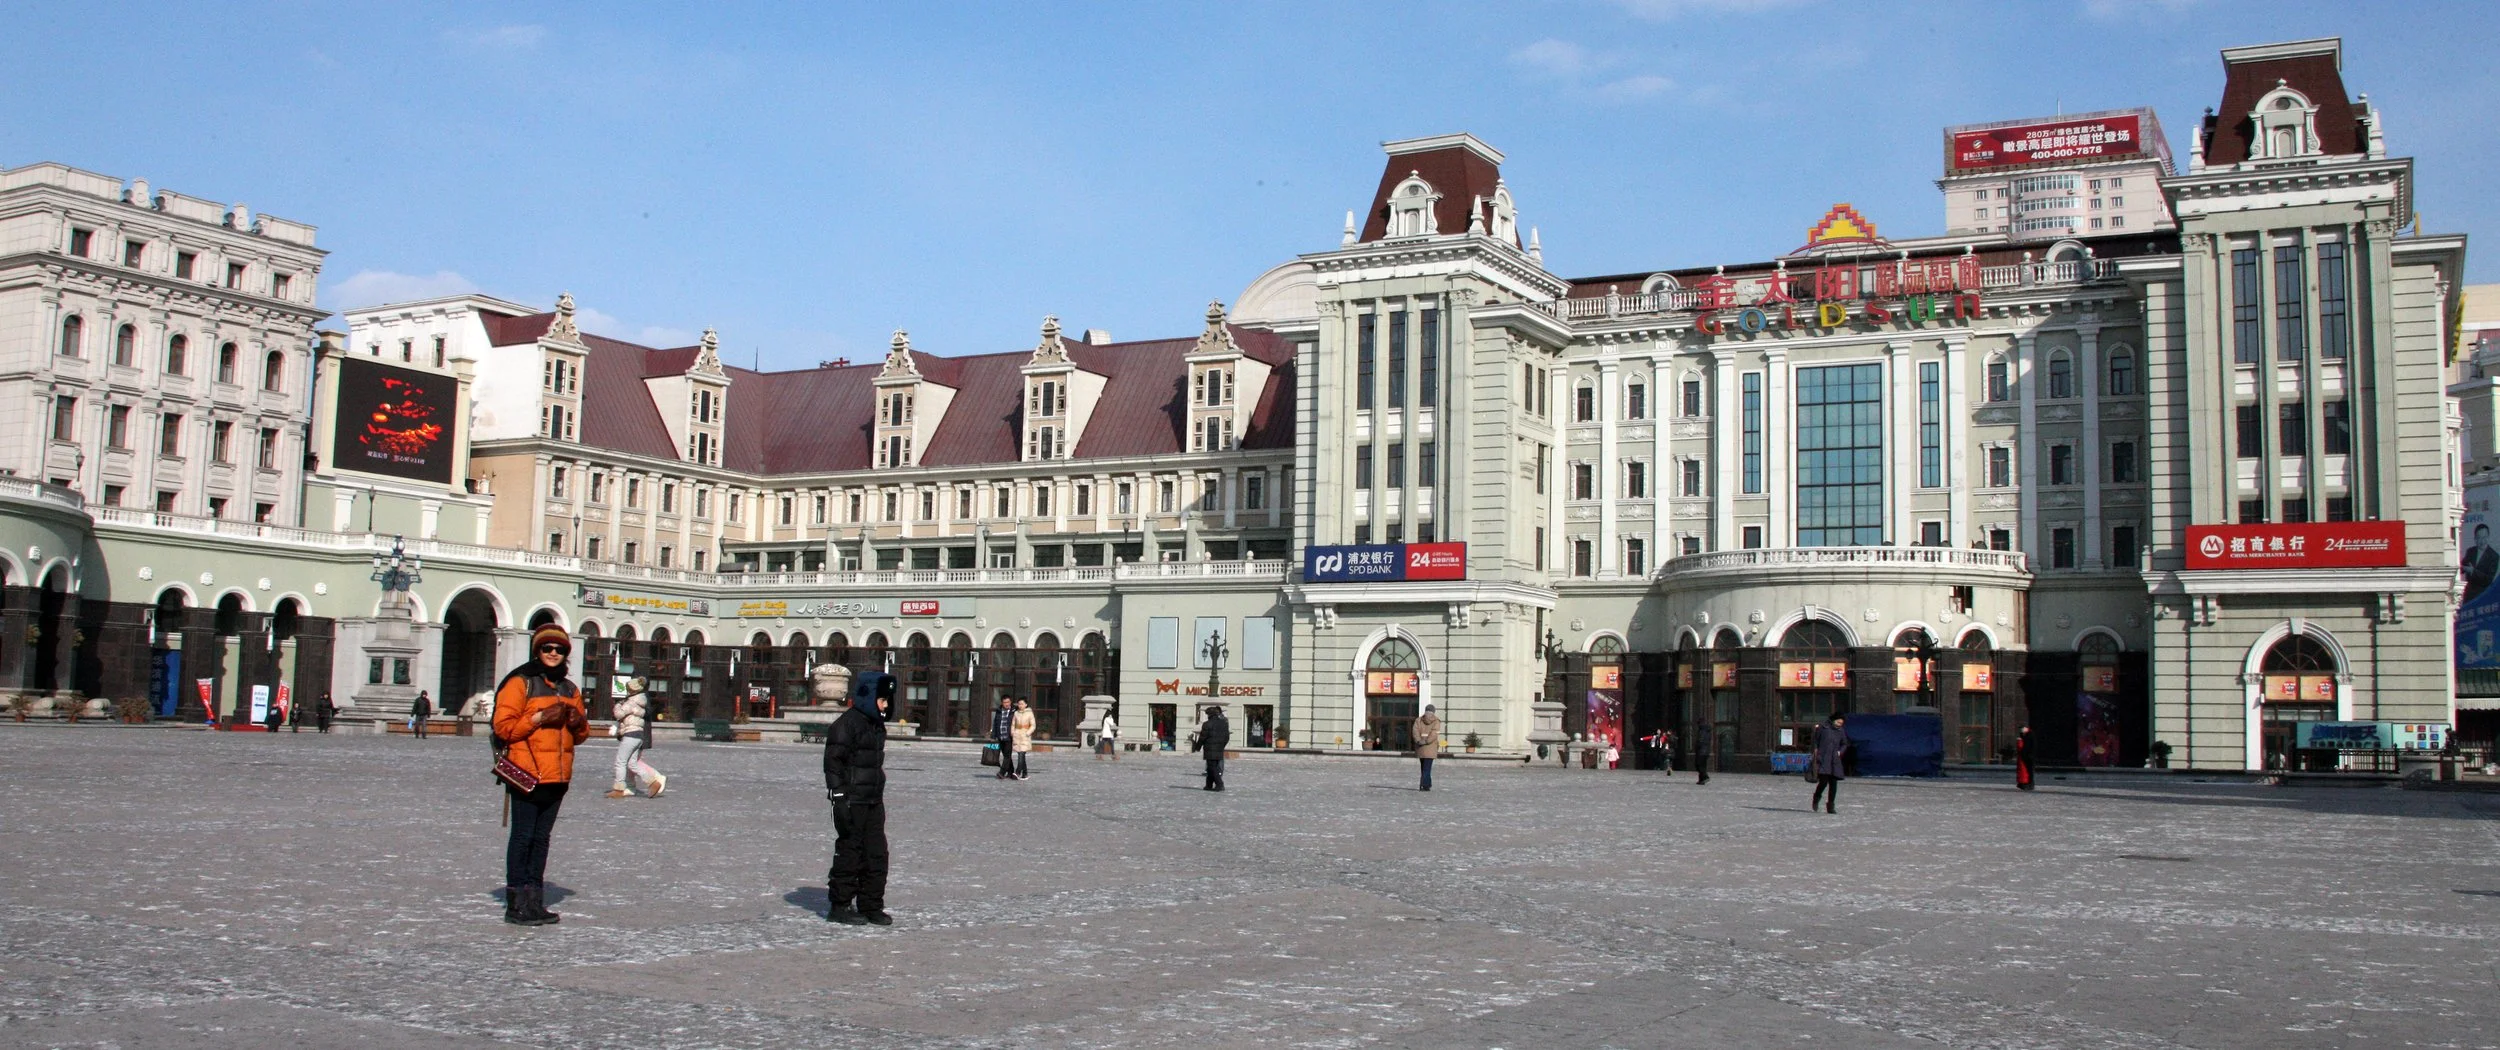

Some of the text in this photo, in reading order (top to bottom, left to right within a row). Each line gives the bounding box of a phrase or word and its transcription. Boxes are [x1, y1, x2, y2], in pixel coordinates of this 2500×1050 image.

[2031, 146, 2103, 159] 400-000-7878
[1694, 267, 1860, 309] 金太阳
[2230, 536, 2305, 552] 招商银行
[2324, 538, 2344, 551] 24
[1347, 551, 1395, 565] 浦发银行
[1410, 552, 1430, 567] 24
[1349, 565, 1392, 575] SPD BANK
